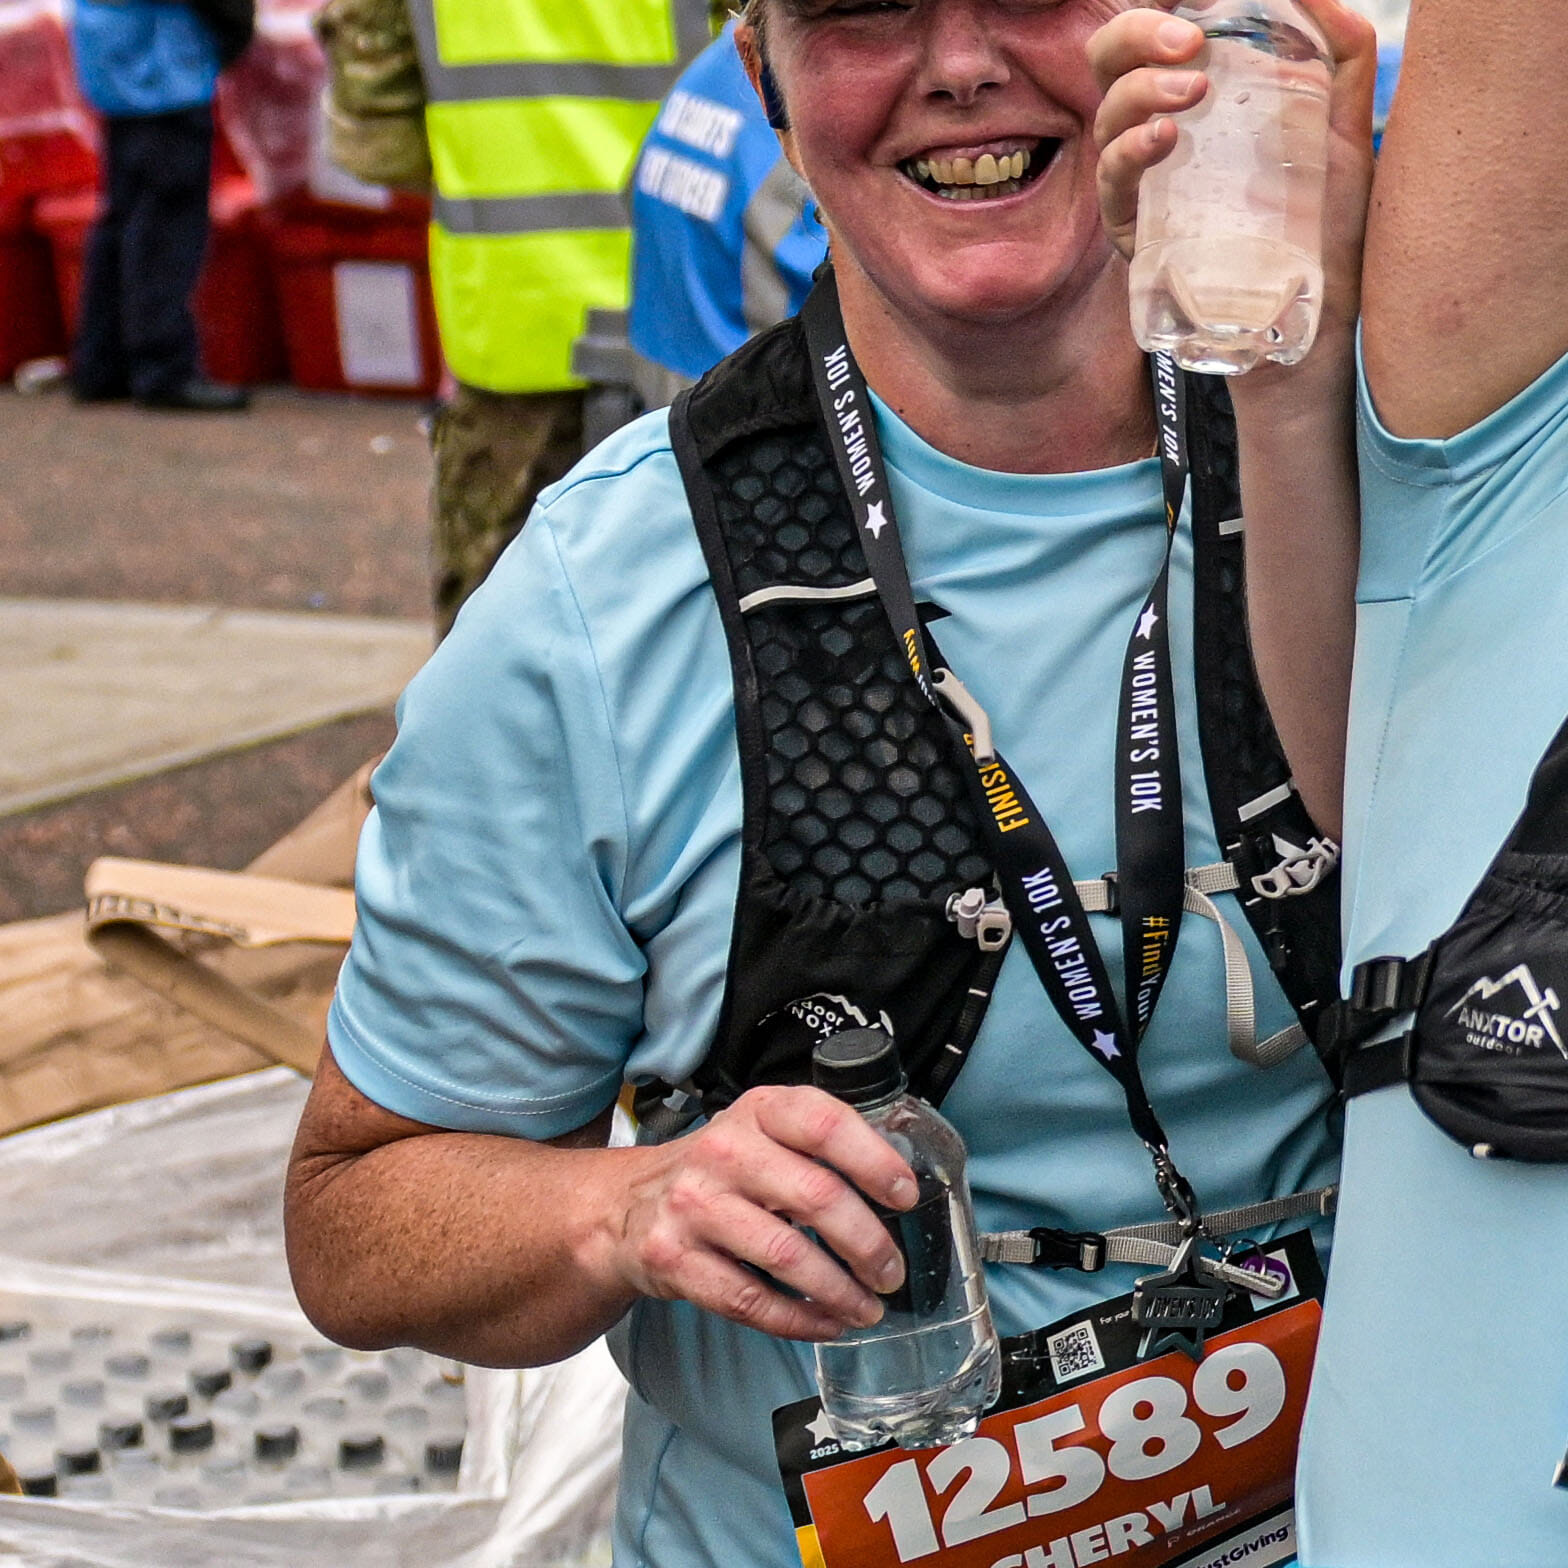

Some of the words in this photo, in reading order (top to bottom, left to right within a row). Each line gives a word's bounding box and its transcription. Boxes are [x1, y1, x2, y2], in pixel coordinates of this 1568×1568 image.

[824, 344, 851, 391] 10K
[834, 389, 876, 497] WOMEN'S
[1162, 423, 1180, 467] 10K
[1131, 651, 1159, 762] WOMEN'S
[1131, 772, 1163, 815] 10K
[1021, 867, 1064, 914] 10K
[1040, 915, 1104, 1021] WOMEN'S
[1457, 1007, 1546, 1049] ANXTOR
[1466, 1032, 1522, 1057] outdoor
[809, 1443, 840, 1461] 2025
[863, 1342, 1287, 1564] 12589
